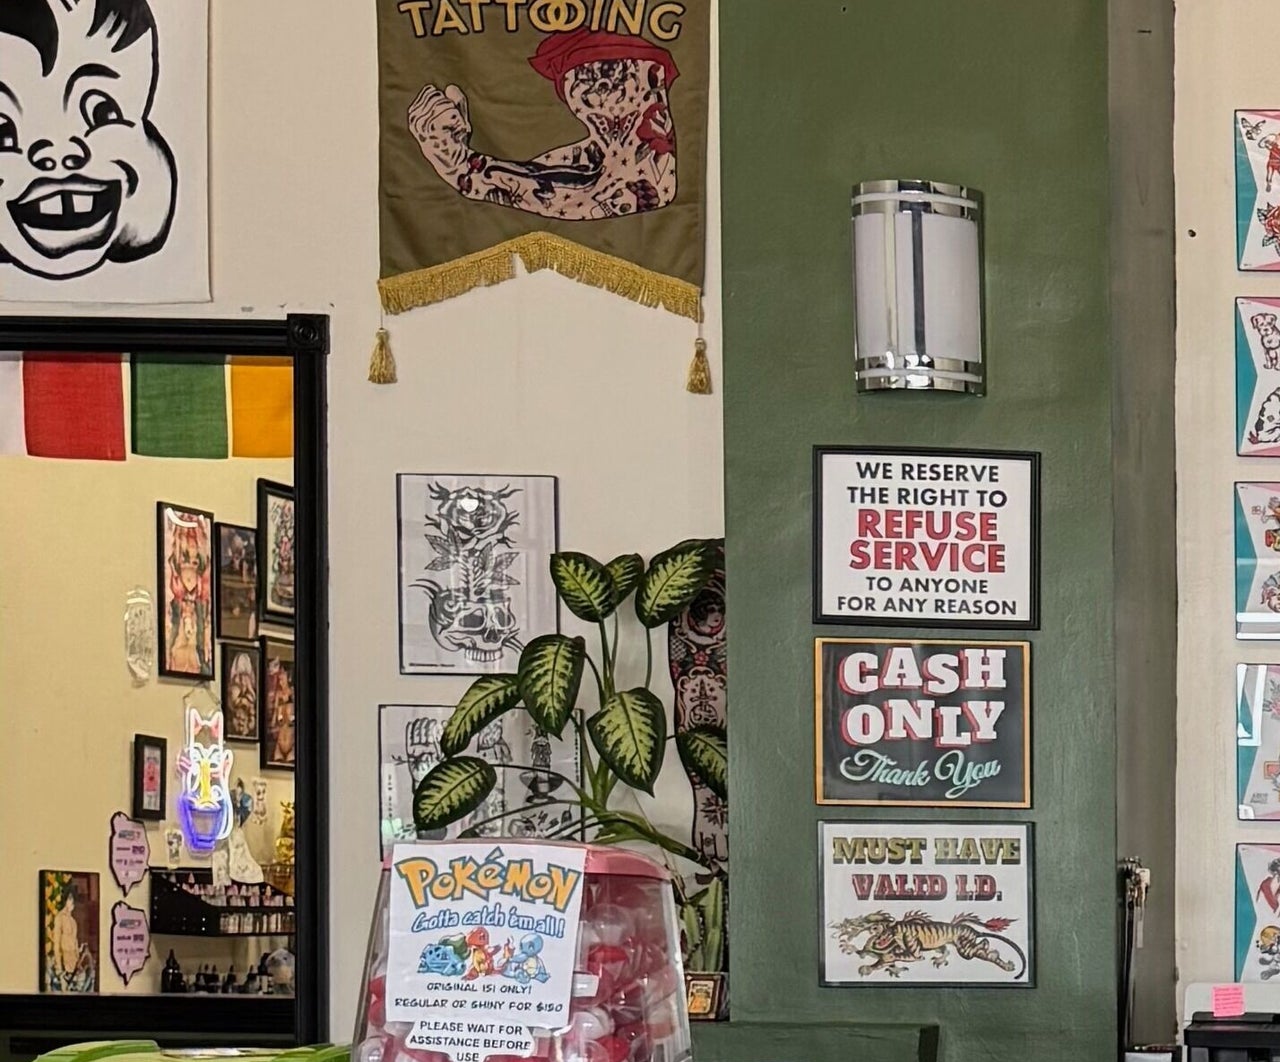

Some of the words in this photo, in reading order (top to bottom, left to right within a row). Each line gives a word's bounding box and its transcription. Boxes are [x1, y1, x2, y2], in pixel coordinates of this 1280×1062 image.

[398, 0, 686, 41] TATTOOING
[856, 461, 893, 480] WE
[901, 463, 999, 482] RESERVE
[847, 486, 889, 504] THE
[897, 488, 970, 506] RIGHT
[976, 490, 1008, 508] TO
[857, 508, 998, 542] REFUSE
[849, 540, 1006, 573] SERVICE
[866, 576, 892, 592] TO
[899, 577, 988, 594] ANYONE
[838, 596, 877, 611] FOR
[883, 598, 928, 613] ANY
[934, 599, 1017, 615] REASON
[838, 647, 1007, 697] CASH
[840, 699, 1005, 748] ONLY
[840, 749, 931, 787] Thank
[934, 750, 1001, 800] You
[833, 837, 927, 864] MUST
[935, 838, 1021, 865] HAVE
[852, 874, 948, 901] VALID
[955, 874, 1003, 901] I.D.
[411, 909, 460, 933] Gotta
[461, 902, 505, 926] catch
[535, 914, 566, 938] all!
[427, 982, 478, 993] ORIGINAL
[482, 983, 496, 993] 151
[500, 984, 532, 995] ONLY!
[395, 998, 448, 1009] REGULAR
[452, 999, 467, 1009] OR
[471, 1000, 505, 1011] SHINY
[509, 1001, 532, 1011] FOR
[420, 1021, 464, 1032] PLEASE
[467, 1023, 495, 1034] WAIT
[498, 1025, 522, 1035] FOR
[409, 1035, 479, 1048] ASSISTANCE
[483, 1039, 531, 1050] BEFORE
[456, 1052, 480, 1062] USE
